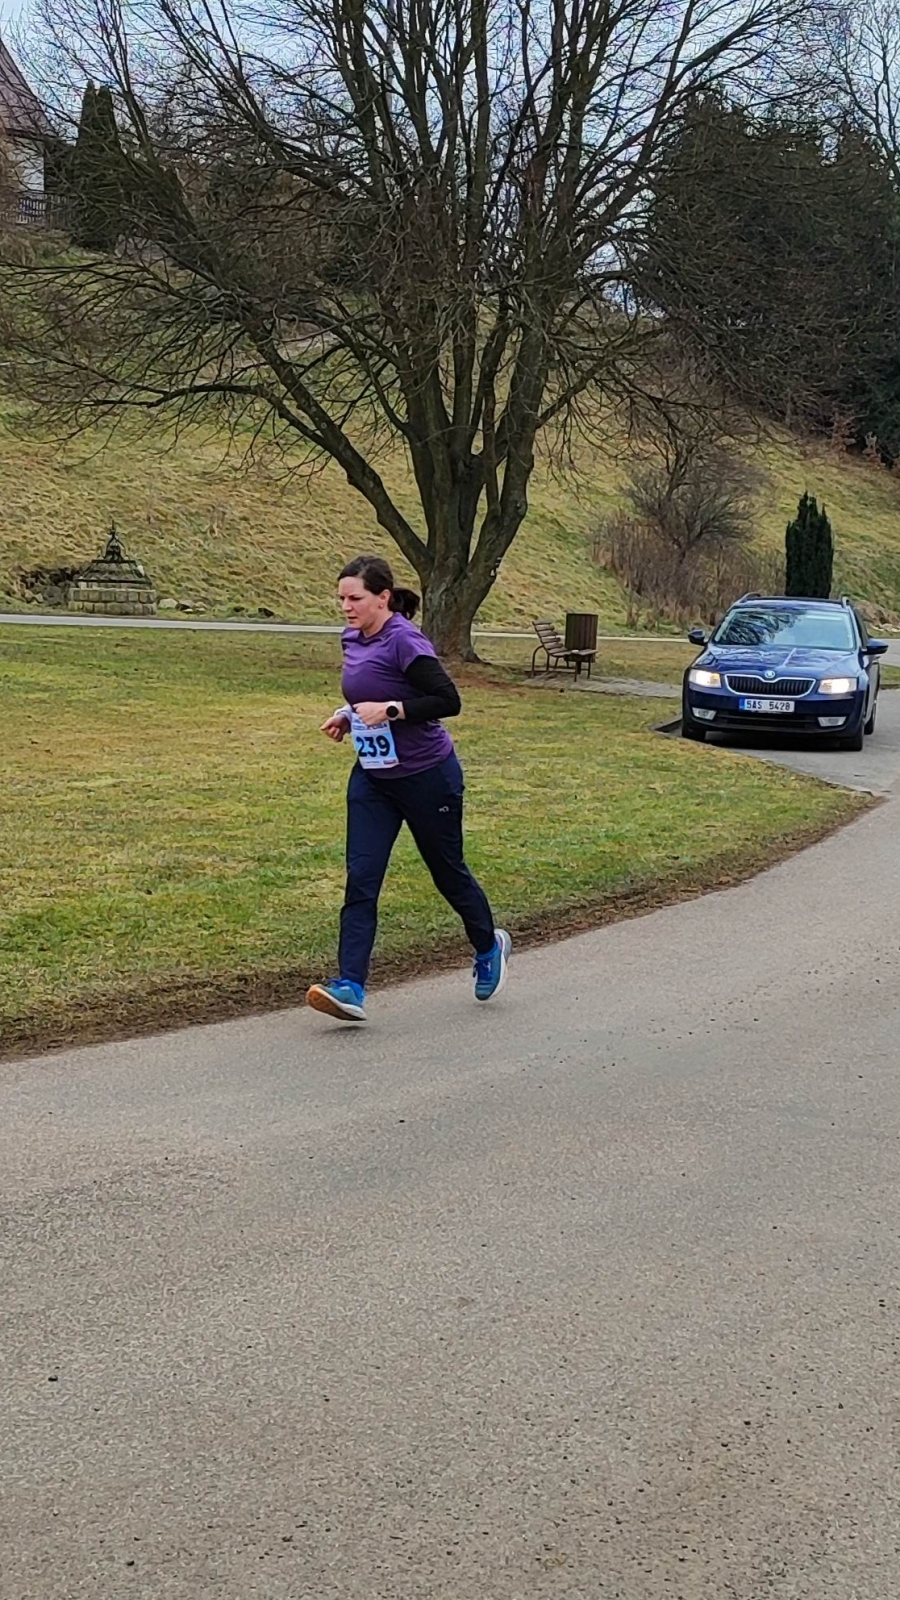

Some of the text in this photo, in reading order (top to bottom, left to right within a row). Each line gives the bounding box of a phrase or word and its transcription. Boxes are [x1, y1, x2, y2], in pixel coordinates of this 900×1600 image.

[746, 700, 791, 711] 5AS 5428
[356, 735, 391, 757] 239
